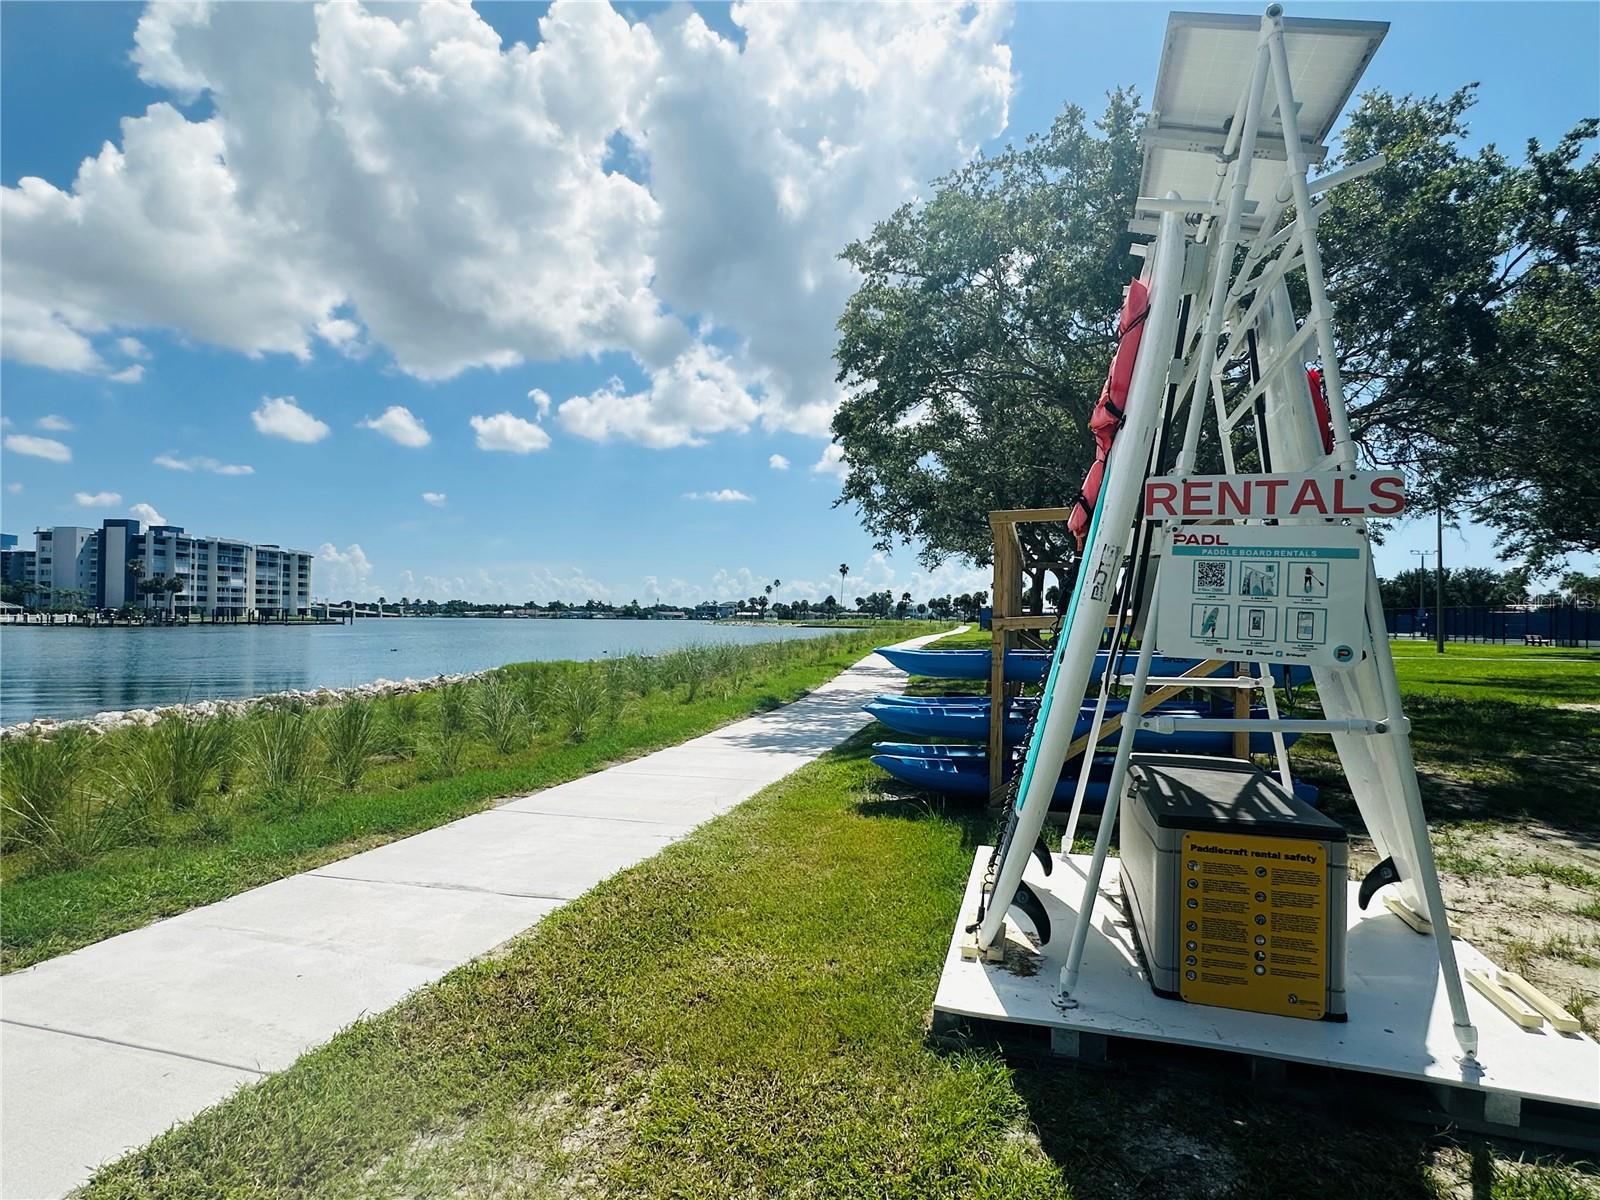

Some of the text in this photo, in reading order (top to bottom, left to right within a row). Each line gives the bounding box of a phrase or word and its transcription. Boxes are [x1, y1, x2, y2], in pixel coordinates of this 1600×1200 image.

[1145, 477, 1406, 516] RENTALS
[1173, 533, 1229, 546] PADL
[1201, 548, 1318, 558] PADDLE BOARD RENTALS
[1190, 844, 1317, 865] Paddlecraft rental safety
